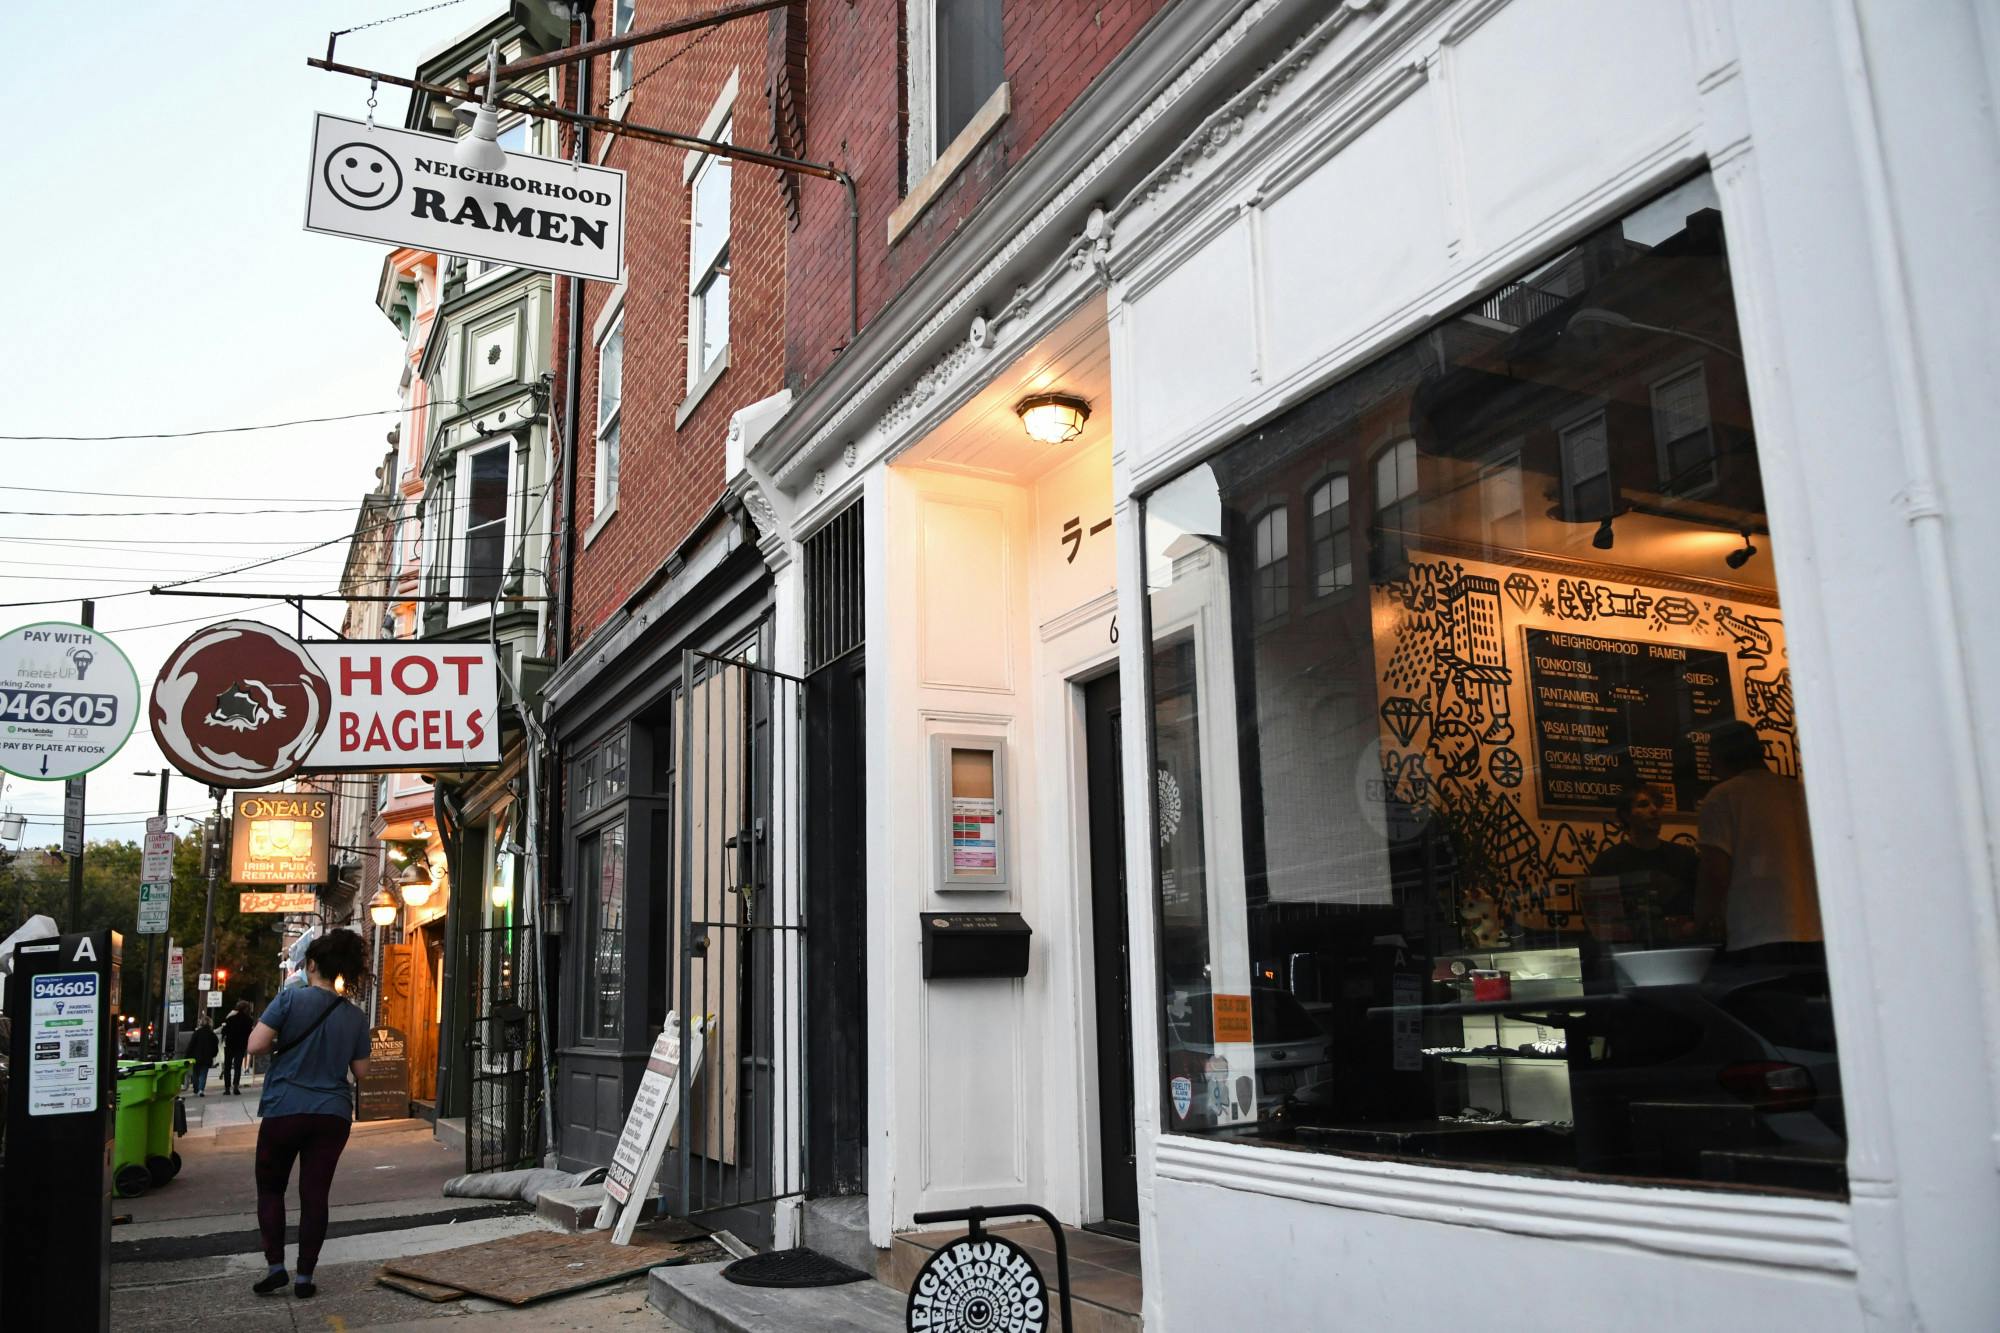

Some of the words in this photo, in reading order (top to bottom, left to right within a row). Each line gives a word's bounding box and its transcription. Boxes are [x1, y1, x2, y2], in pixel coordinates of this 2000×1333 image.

[414, 157, 612, 207] NEIGHBORHOOD
[410, 186, 608, 250] RAMEN
[24, 630, 51, 643] PAY
[54, 632, 92, 645] WITH
[1551, 633, 1639, 656] NEIGHBORHOOD
[1648, 645, 1687, 661] RAMEN
[1535, 656, 1592, 674] TONKOTSU
[339, 655, 484, 696] HOT
[1686, 672, 1714, 686] SIDES
[0, 680, 22, 690] rking
[24, 681, 46, 690] Zone
[1538, 686, 1599, 705] TANTANMEN
[339, 708, 485, 752] BAGELS
[1541, 720, 1569, 735] YASAI
[3, 742, 20, 750] PAY
[22, 743, 34, 751] BY
[35, 744, 63, 752] PLATE
[77, 746, 105, 754] KIOSK
[1629, 745, 1673, 760] DESSERT
[241, 870, 318, 880] RESTAURANT
[142, 885, 149, 900] 2
[72, 936, 97, 962] A
[36, 981, 94, 997] 946605
[371, 1041, 404, 1049] UINNESS
